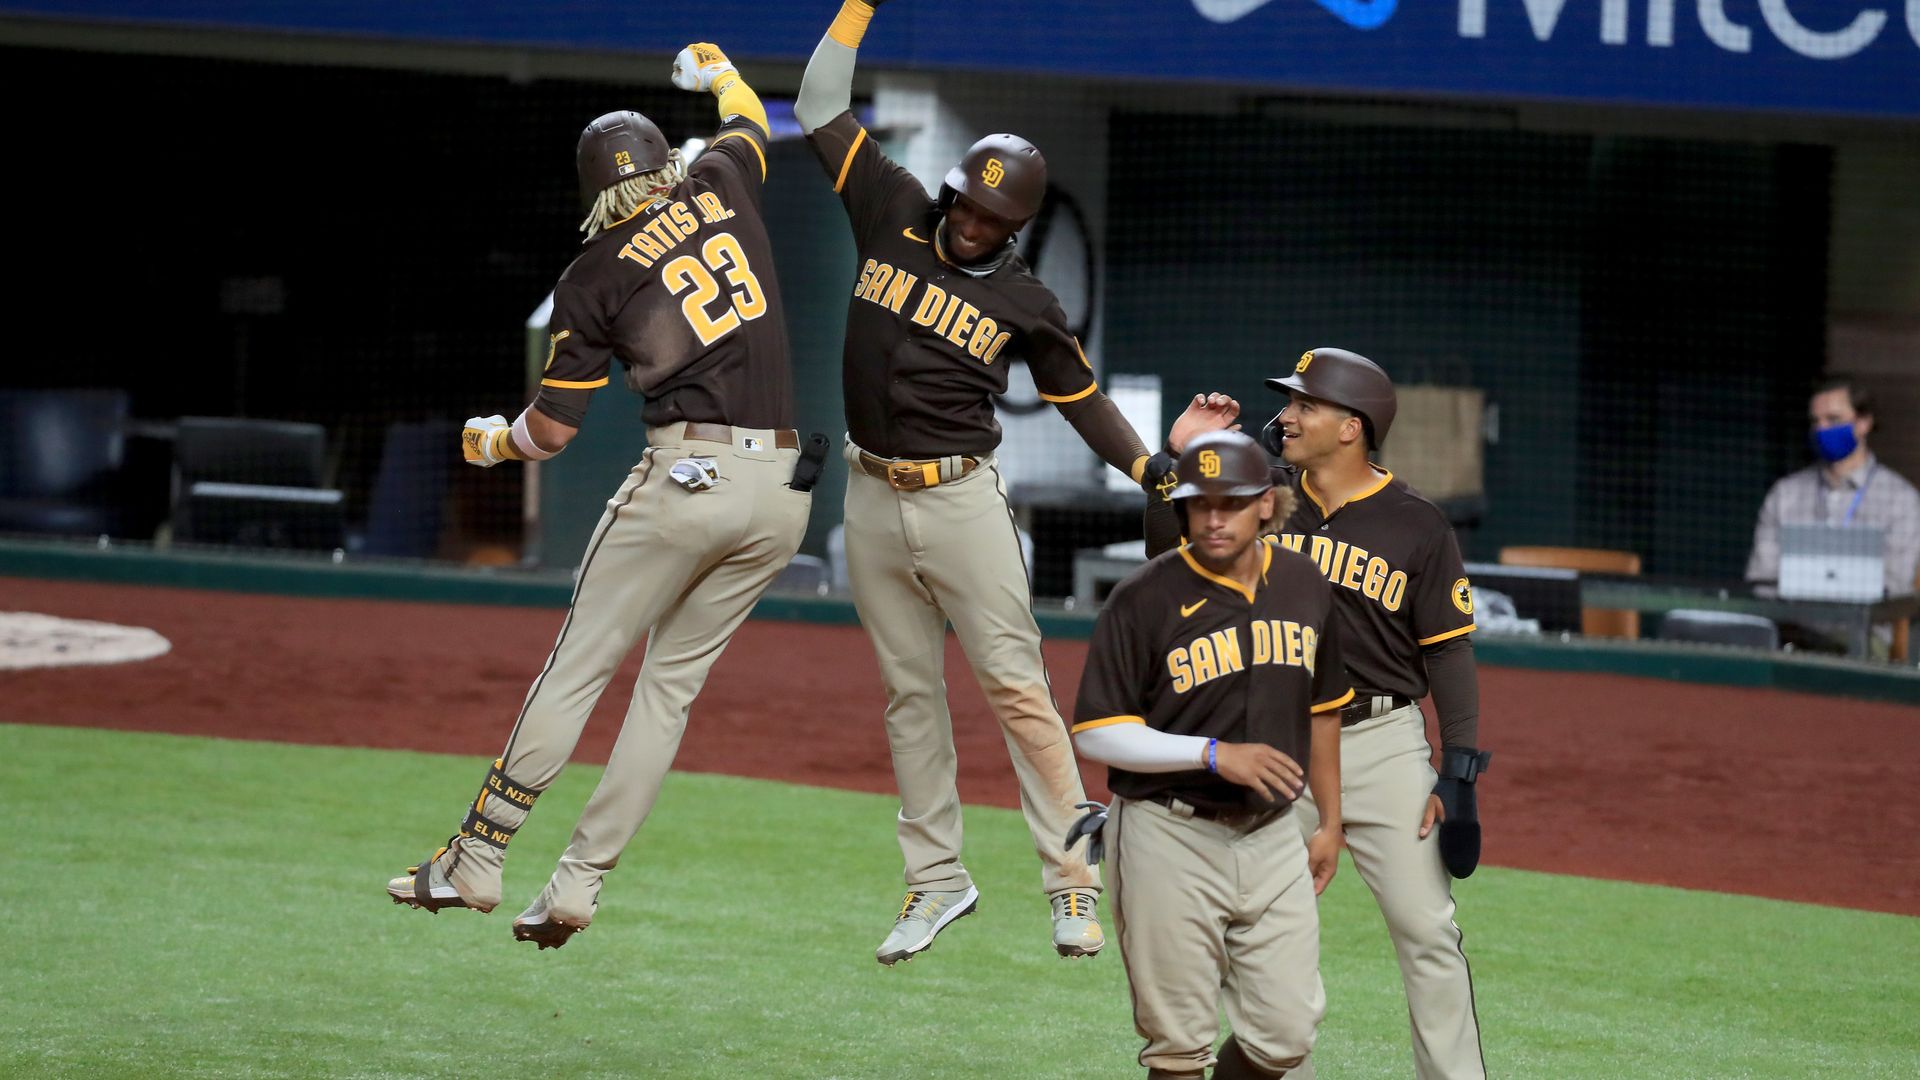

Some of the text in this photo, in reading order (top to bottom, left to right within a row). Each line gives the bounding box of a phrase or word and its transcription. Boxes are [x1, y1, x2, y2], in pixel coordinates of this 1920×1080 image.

[615, 150, 631, 166] 23
[982, 158, 1005, 188] SD
[617, 191, 736, 269] TATIS JR.
[661, 232, 768, 347] 23
[854, 258, 1012, 365] SAN DIEGO
[1199, 449, 1221, 478] SD
[1310, 535, 1408, 612] DIEGO
[1166, 620, 1319, 694] SAN DIEG
[489, 774, 503, 792] EL
[473, 820, 488, 837] EL
